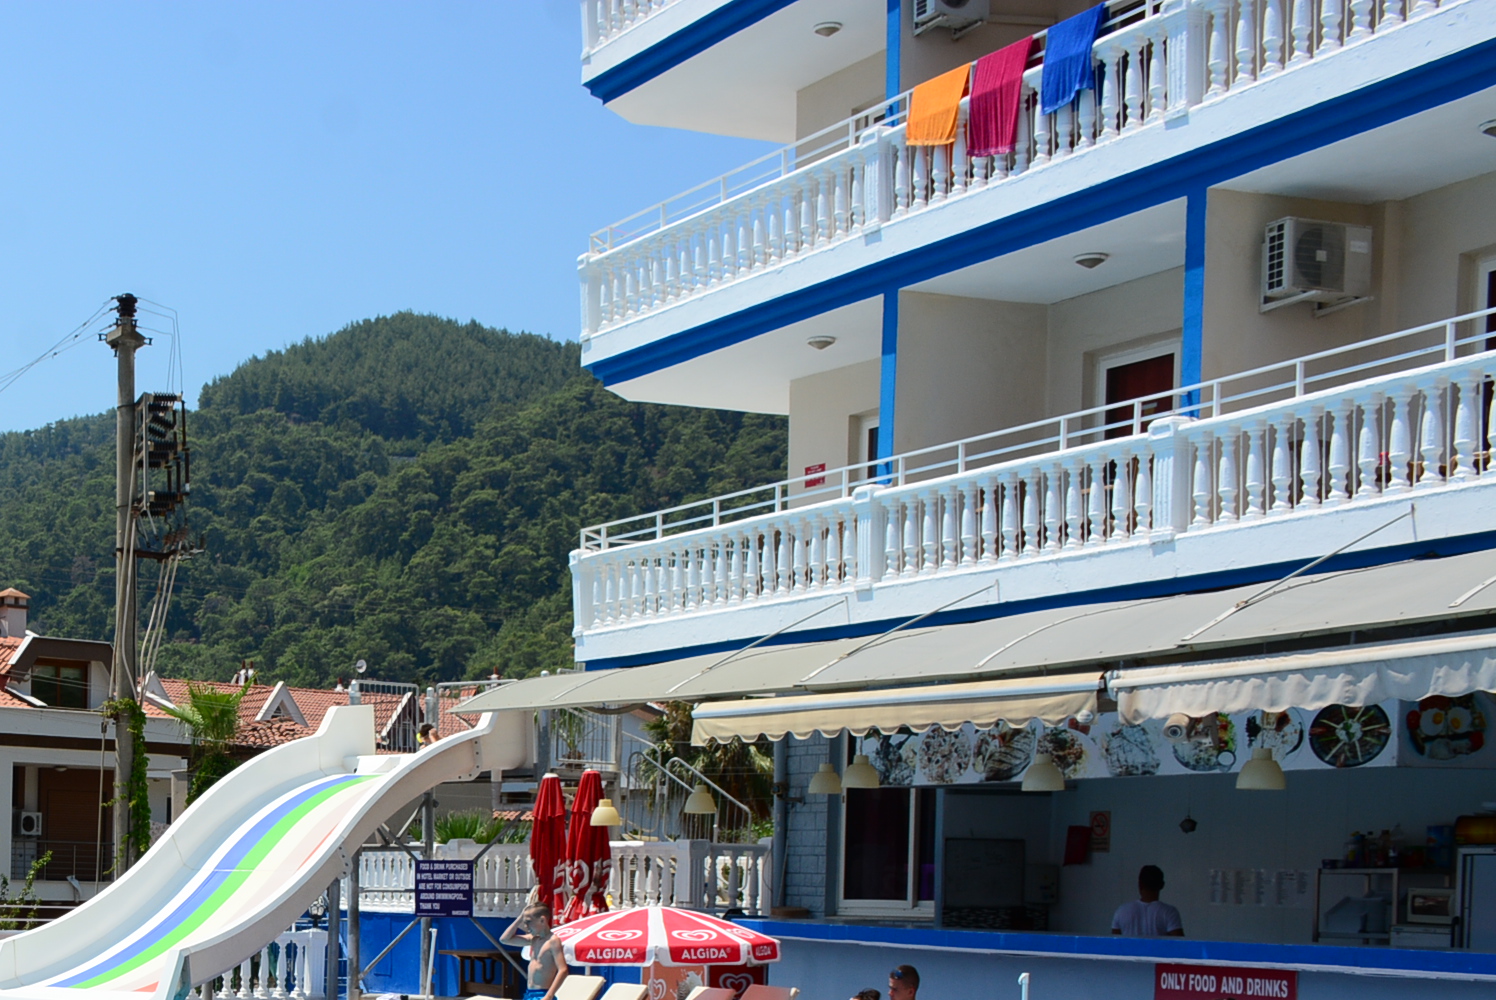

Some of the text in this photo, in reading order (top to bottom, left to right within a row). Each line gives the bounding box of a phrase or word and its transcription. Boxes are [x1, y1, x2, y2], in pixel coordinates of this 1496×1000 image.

[1160, 972, 1288, 998] ONLY FOOD AND DRINKS
